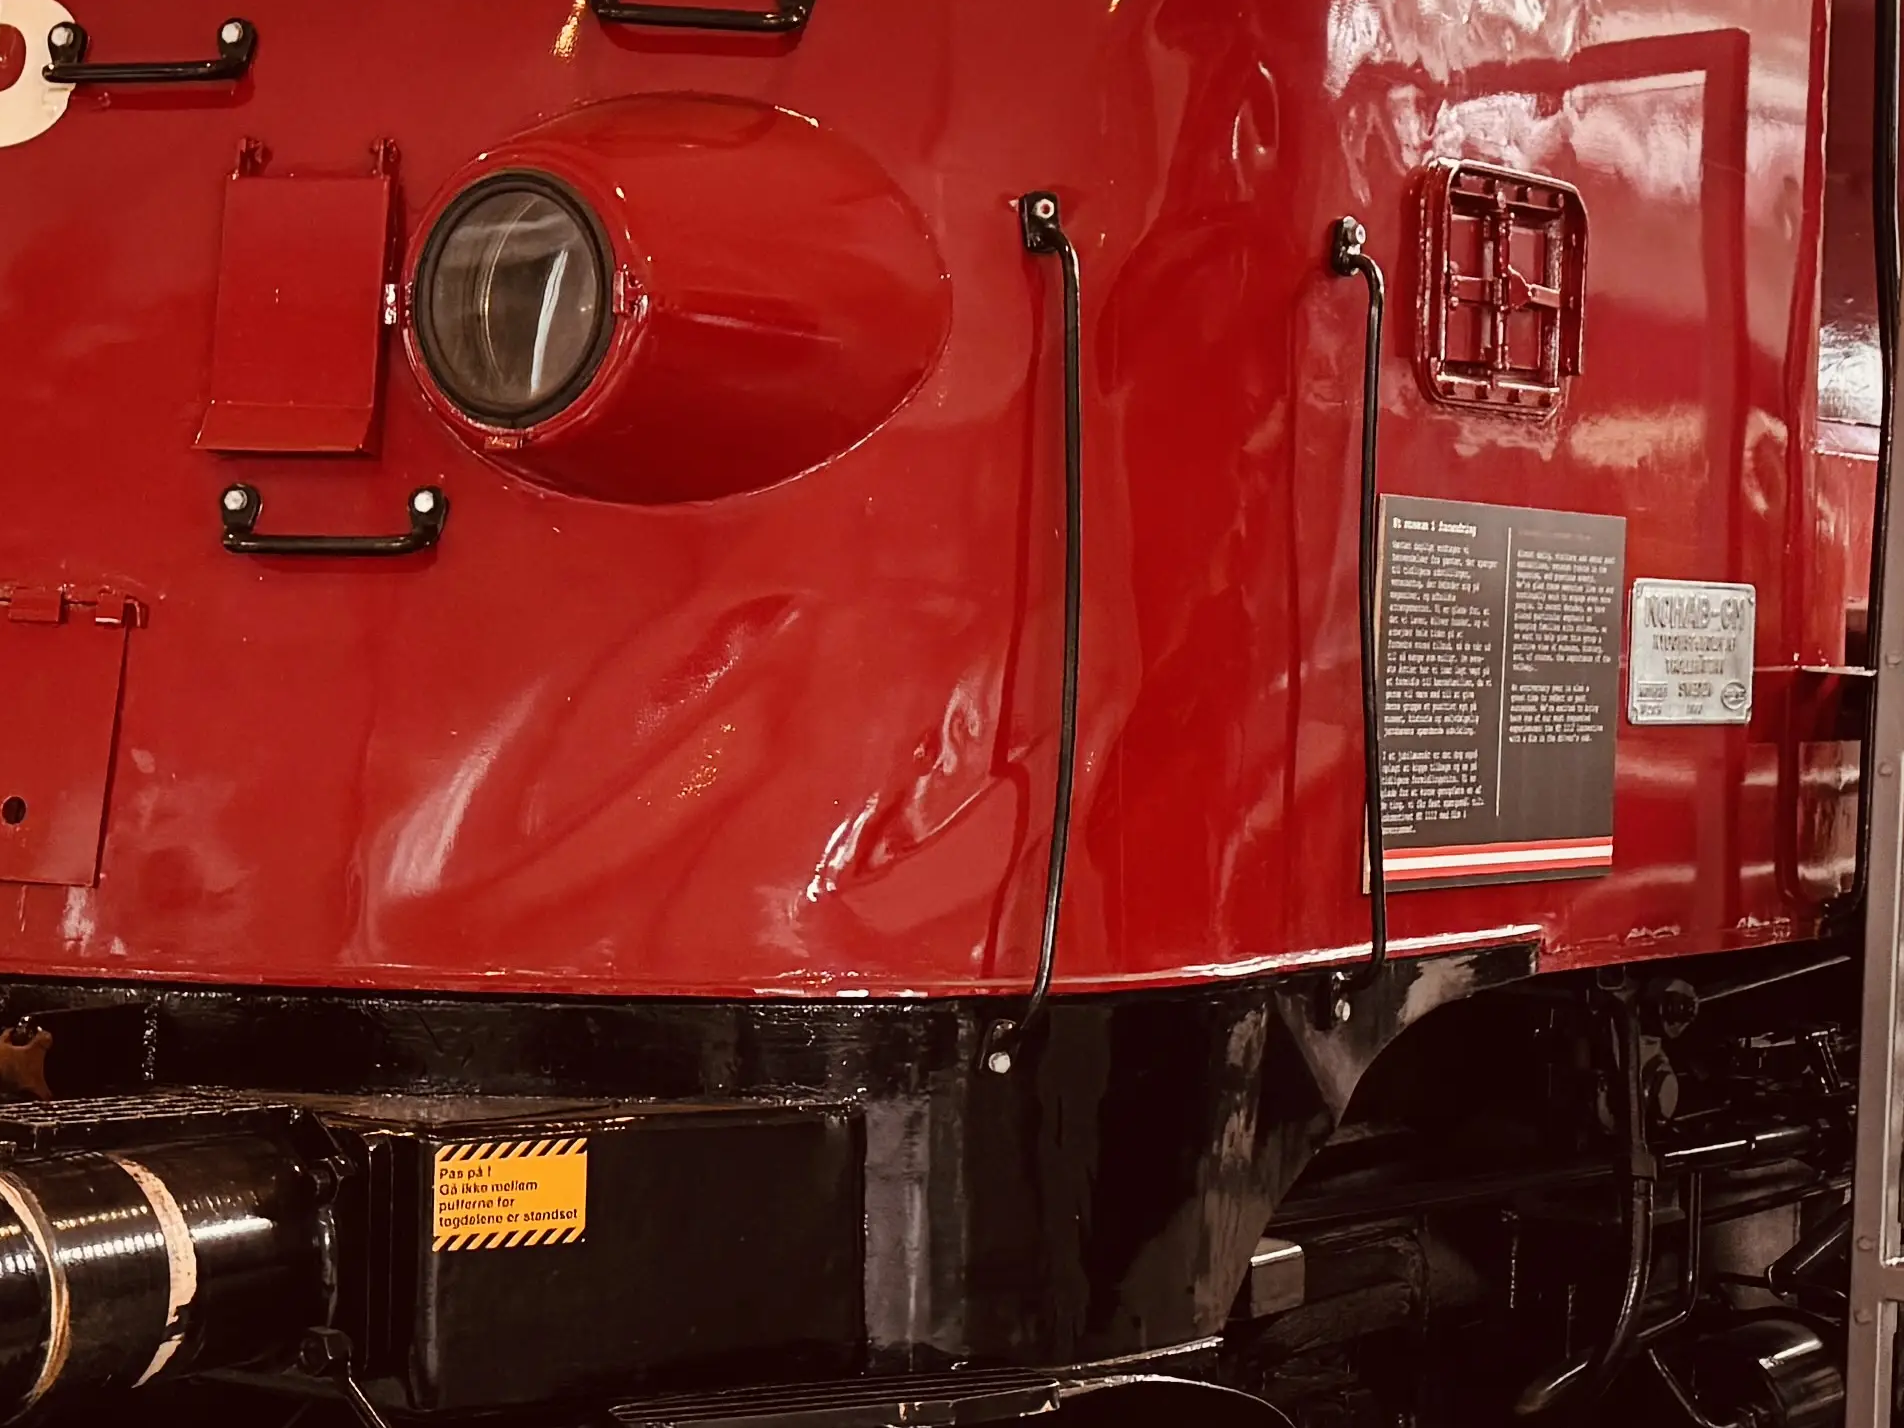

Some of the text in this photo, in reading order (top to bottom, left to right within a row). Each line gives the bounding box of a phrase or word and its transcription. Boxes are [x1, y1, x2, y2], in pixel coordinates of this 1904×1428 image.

[439, 1168, 463, 1179] Pas
[467, 1165, 483, 1180] på
[439, 1184, 458, 1196] Gå
[462, 1182, 488, 1194] ikke
[507, 1213, 520, 1223] er
